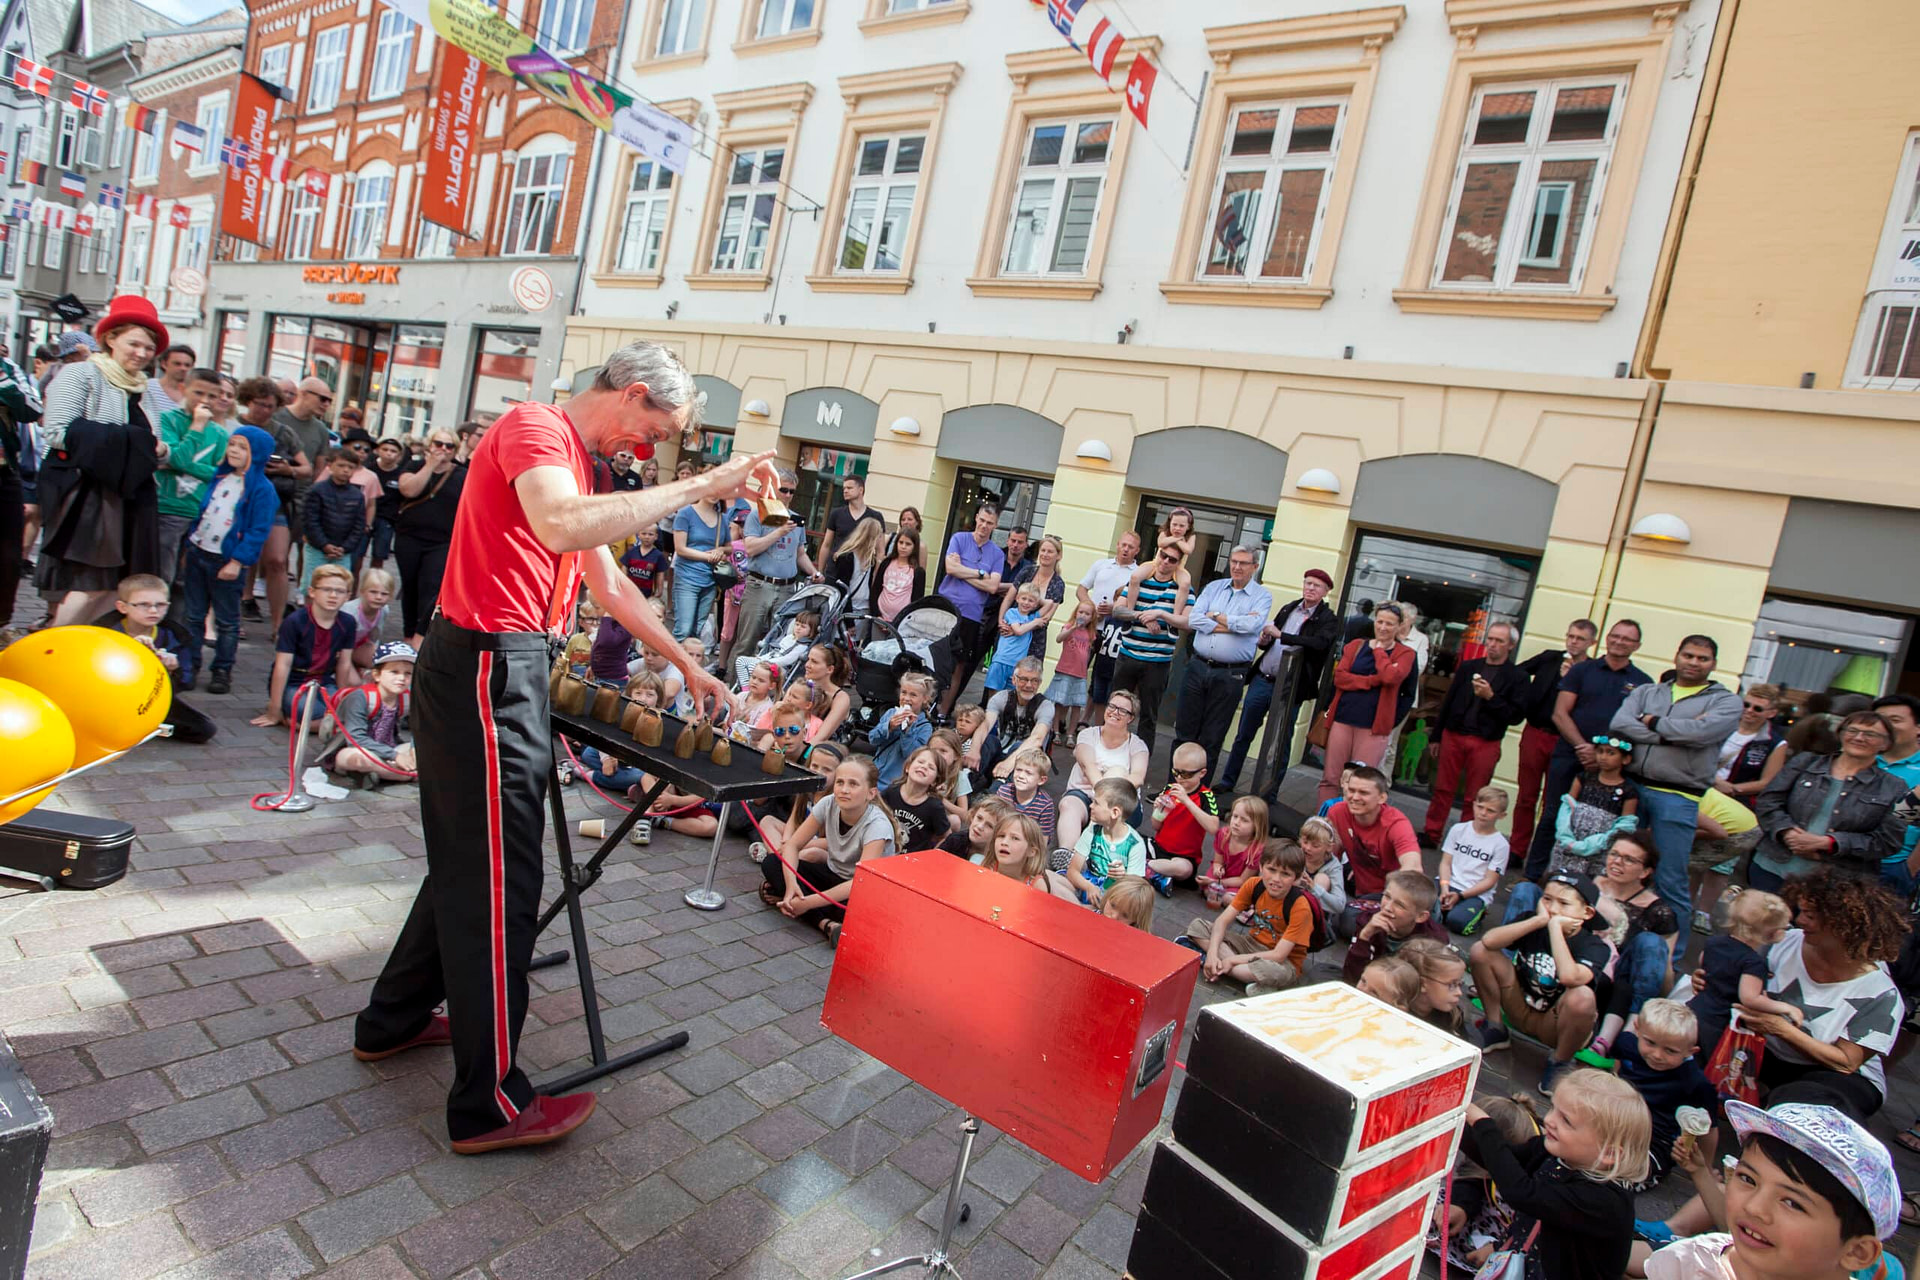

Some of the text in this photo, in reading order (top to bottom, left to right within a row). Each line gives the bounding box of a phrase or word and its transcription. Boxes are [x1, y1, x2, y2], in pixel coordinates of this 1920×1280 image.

[453, 54, 481, 129] PROFIL
[241, 106, 268, 223] PROFIL OPTIK
[444, 145, 465, 208] OPTIK
[356, 265, 401, 285] OPTIK
[816, 400, 843, 428] M
[629, 566, 652, 577] QATAR
[1098, 624, 1123, 659] 26
[894, 809, 922, 824] ACTUALLY
